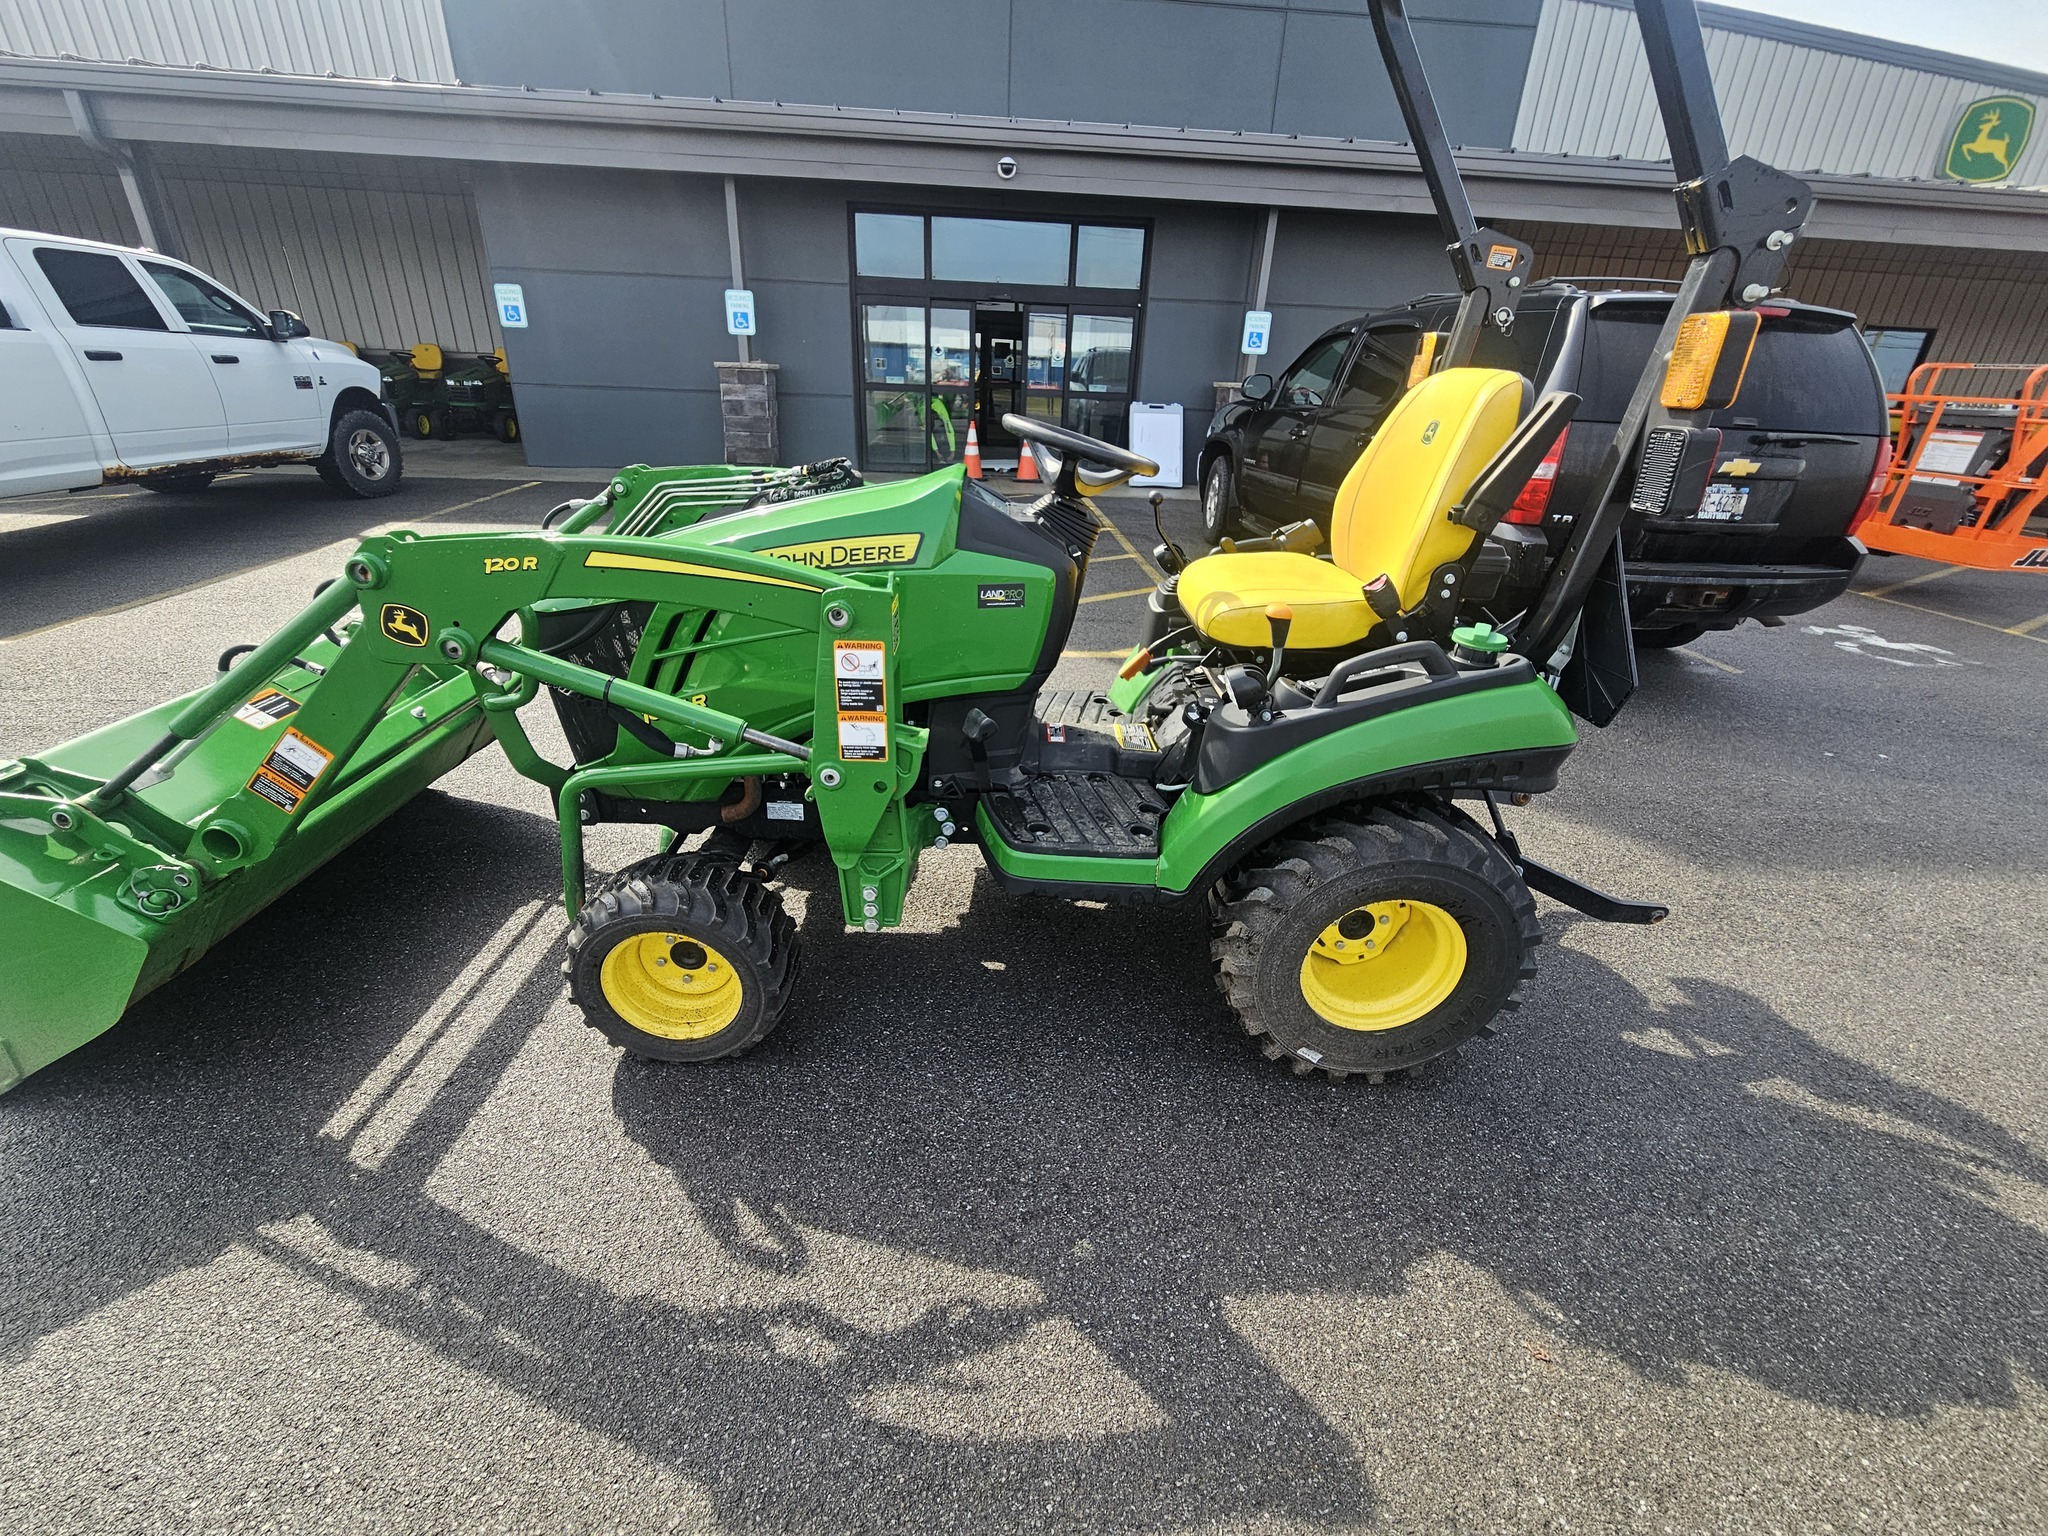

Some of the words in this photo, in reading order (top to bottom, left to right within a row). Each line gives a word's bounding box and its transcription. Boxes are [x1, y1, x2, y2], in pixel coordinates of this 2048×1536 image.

[483, 558, 520, 574] 120
[522, 556, 539, 571] R
[770, 551, 824, 566] HN
[831, 545, 906, 563] DEERE
[2011, 548, 2048, 568] JL
[980, 589, 1024, 599] LANDPRO
[844, 642, 882, 650] WARNING
[299, 735, 328, 757] WARNING
[271, 775, 300, 797] WARNING
